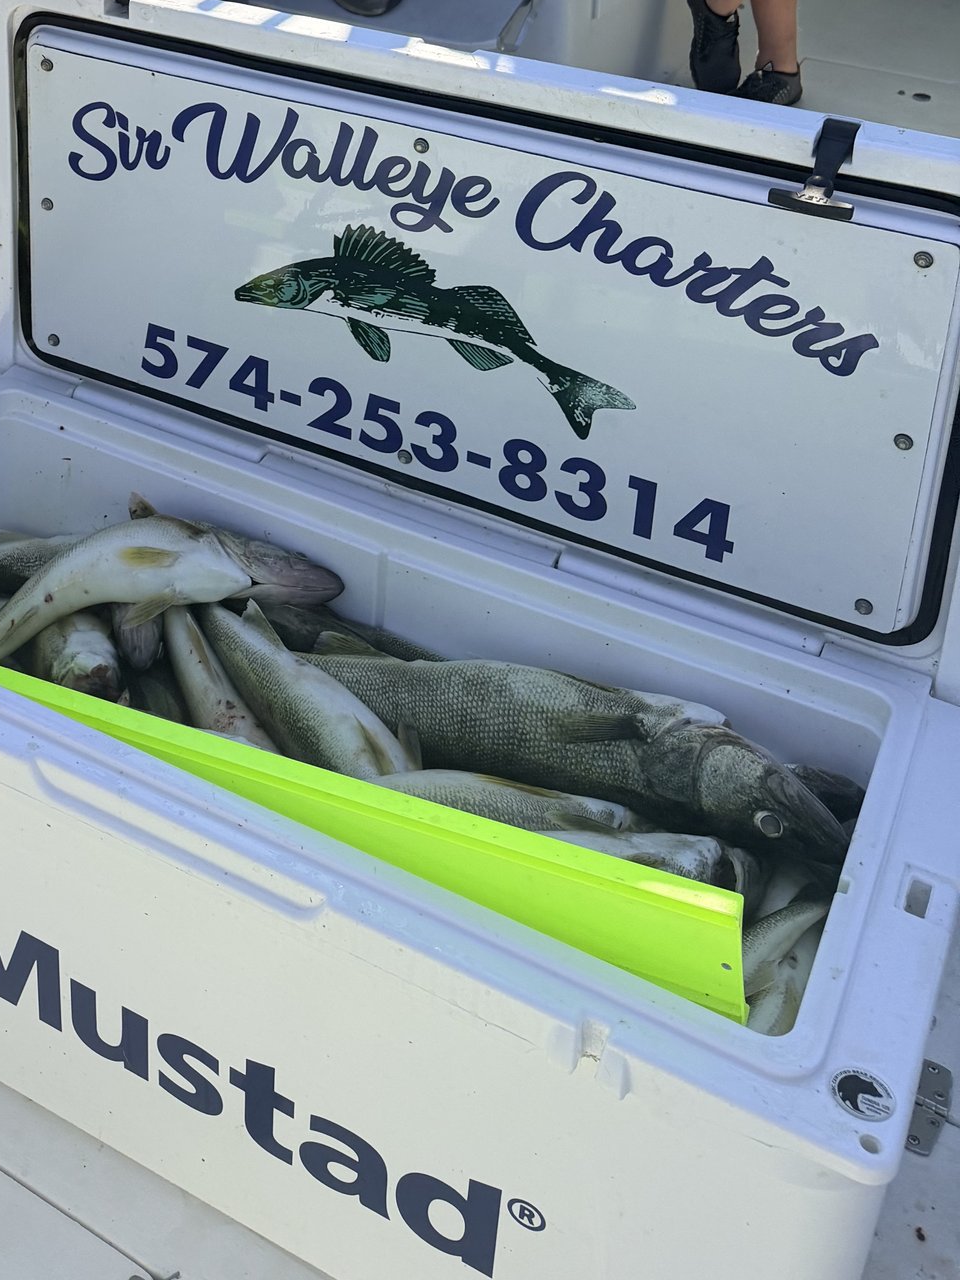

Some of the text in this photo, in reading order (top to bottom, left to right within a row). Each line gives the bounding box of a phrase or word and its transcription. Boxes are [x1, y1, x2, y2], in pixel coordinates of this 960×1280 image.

[67, 101, 881, 378] Sir Walleye Charters
[795, 191, 830, 204] YETI
[141, 322, 737, 564] 574-253-8314
